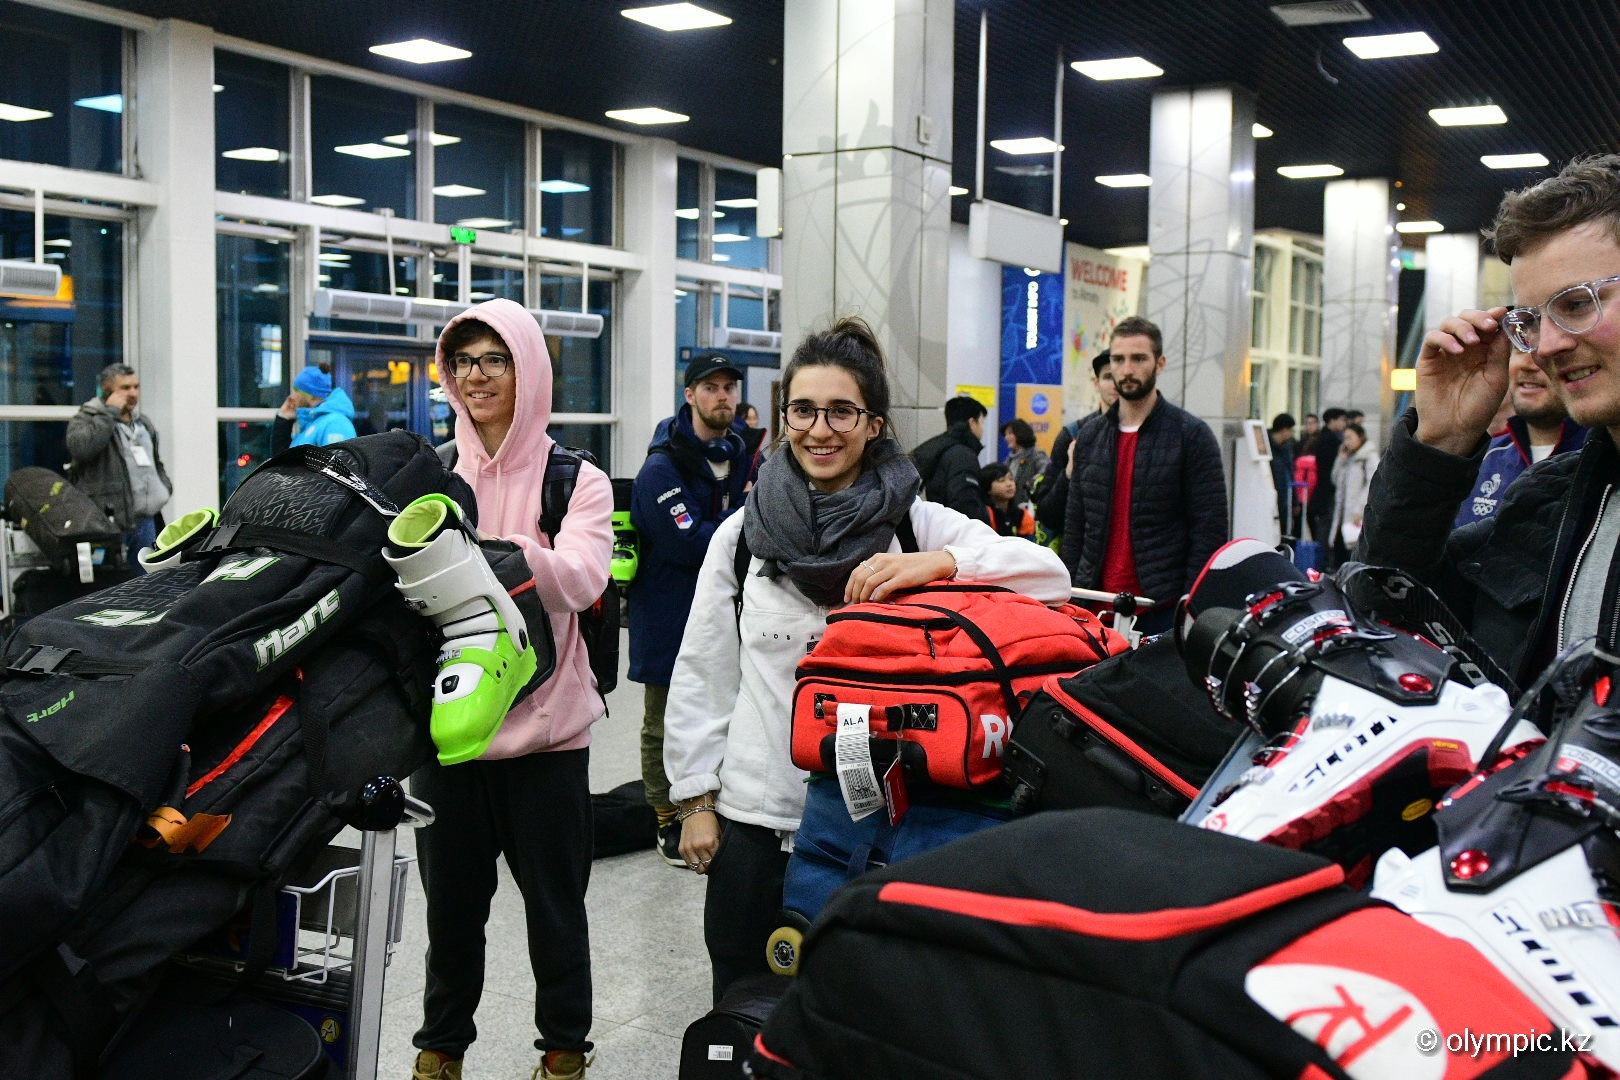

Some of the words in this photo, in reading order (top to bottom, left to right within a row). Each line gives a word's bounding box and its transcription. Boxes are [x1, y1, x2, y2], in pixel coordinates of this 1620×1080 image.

[1072, 259, 1128, 292] WELCOME
[670, 503, 686, 516] GB
[253, 588, 340, 672] Hart
[762, 632, 791, 640] LOS
[27, 690, 75, 723] Hart
[843, 716, 864, 727] ALA
